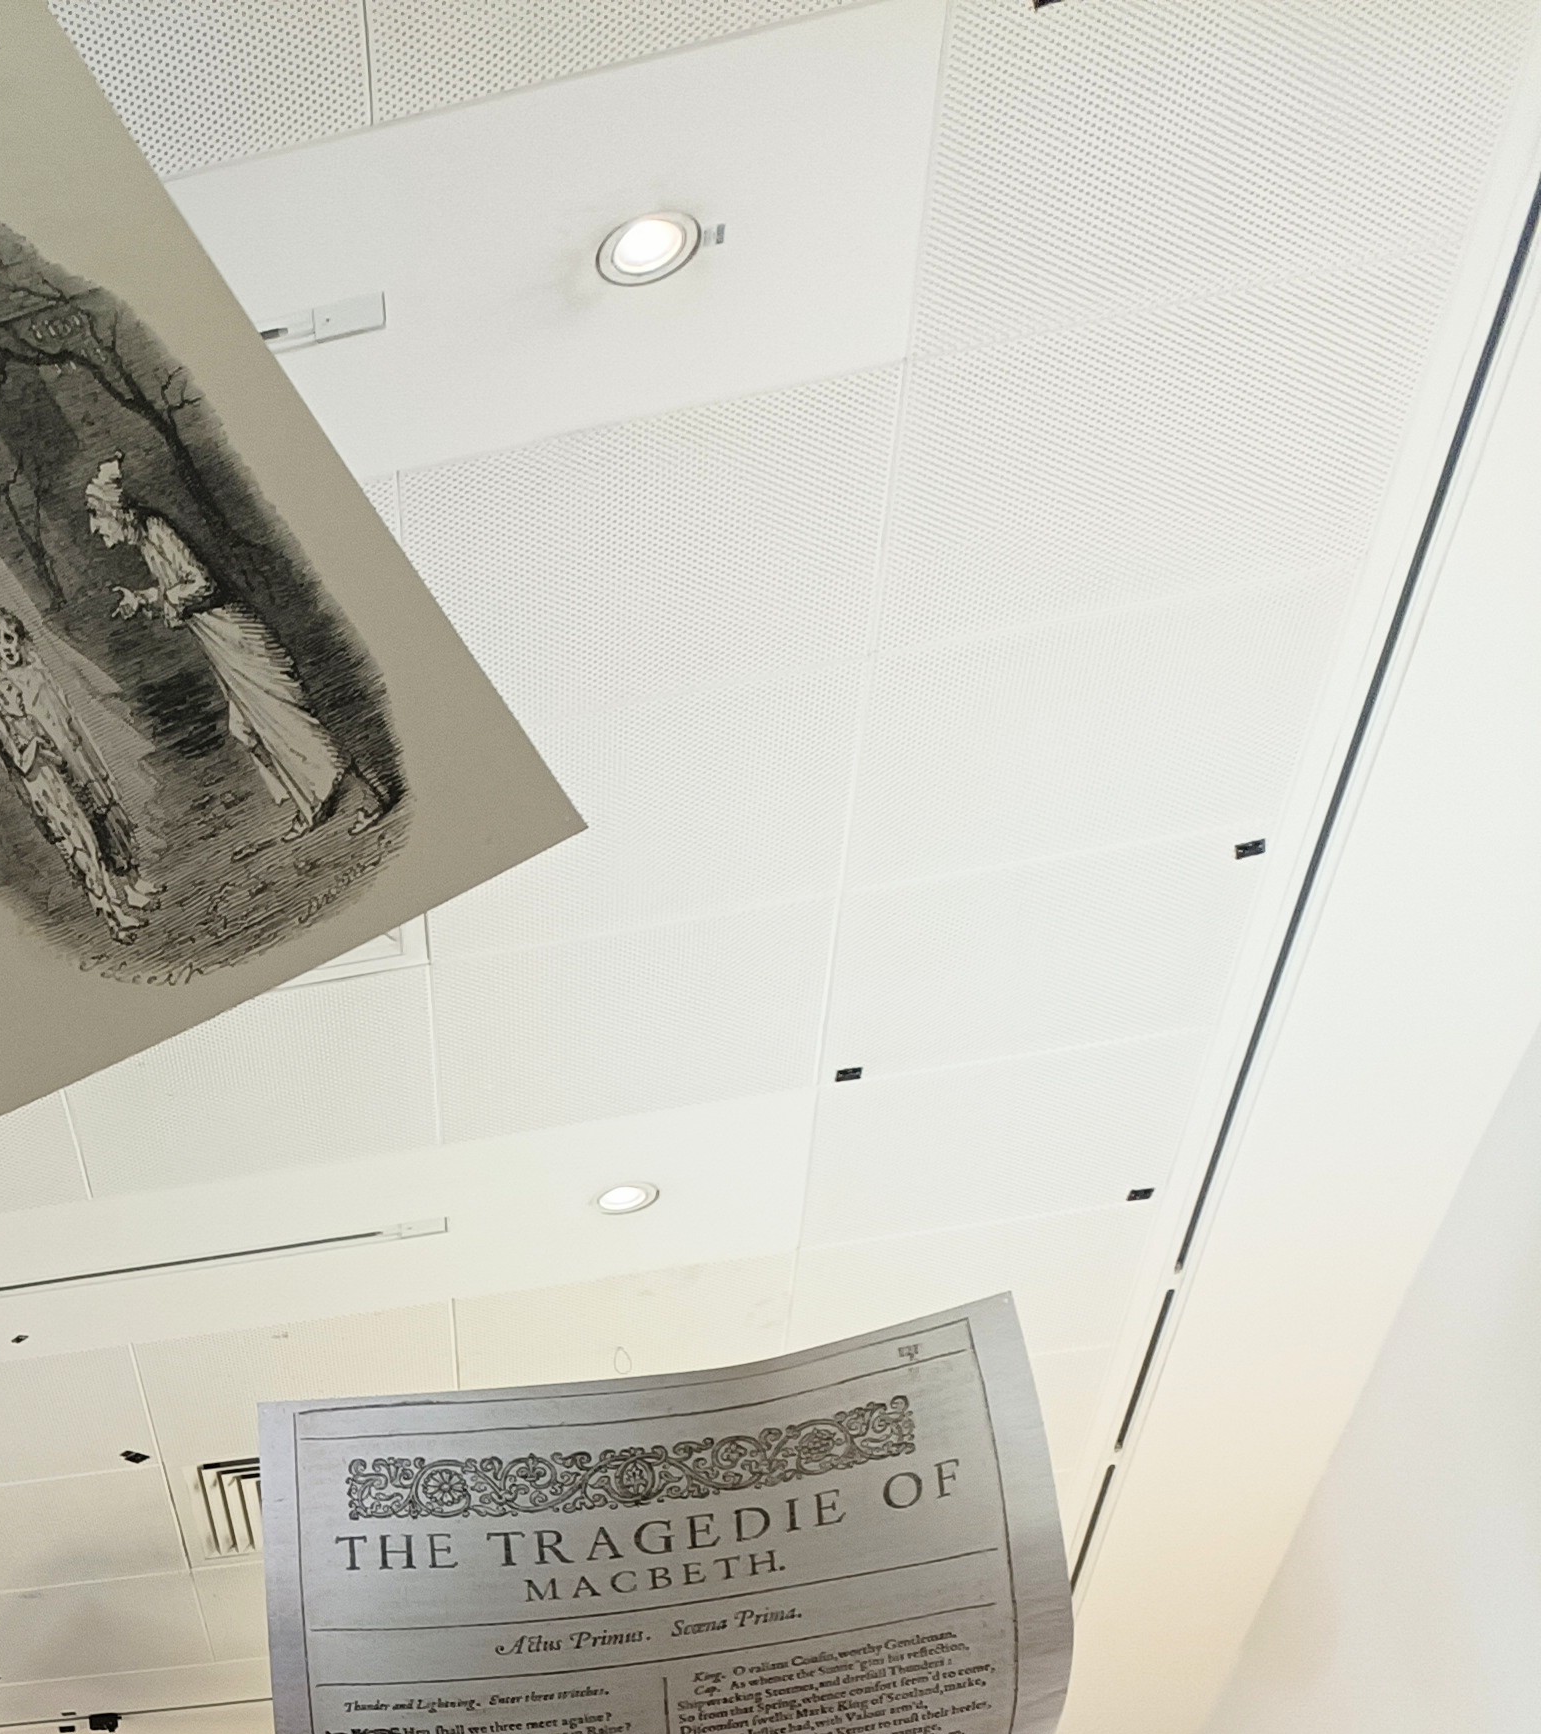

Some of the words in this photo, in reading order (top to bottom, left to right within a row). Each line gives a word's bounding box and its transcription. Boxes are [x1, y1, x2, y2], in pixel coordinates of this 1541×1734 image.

[335, 1531, 458, 1571] THE
[486, 1489, 846, 1566] TRAGEDIE
[882, 1458, 959, 1509] OF
[524, 1549, 785, 1602] MACBETH.
[569, 1629, 651, 1649] Primus.
[734, 1607, 802, 1628] Prima.
